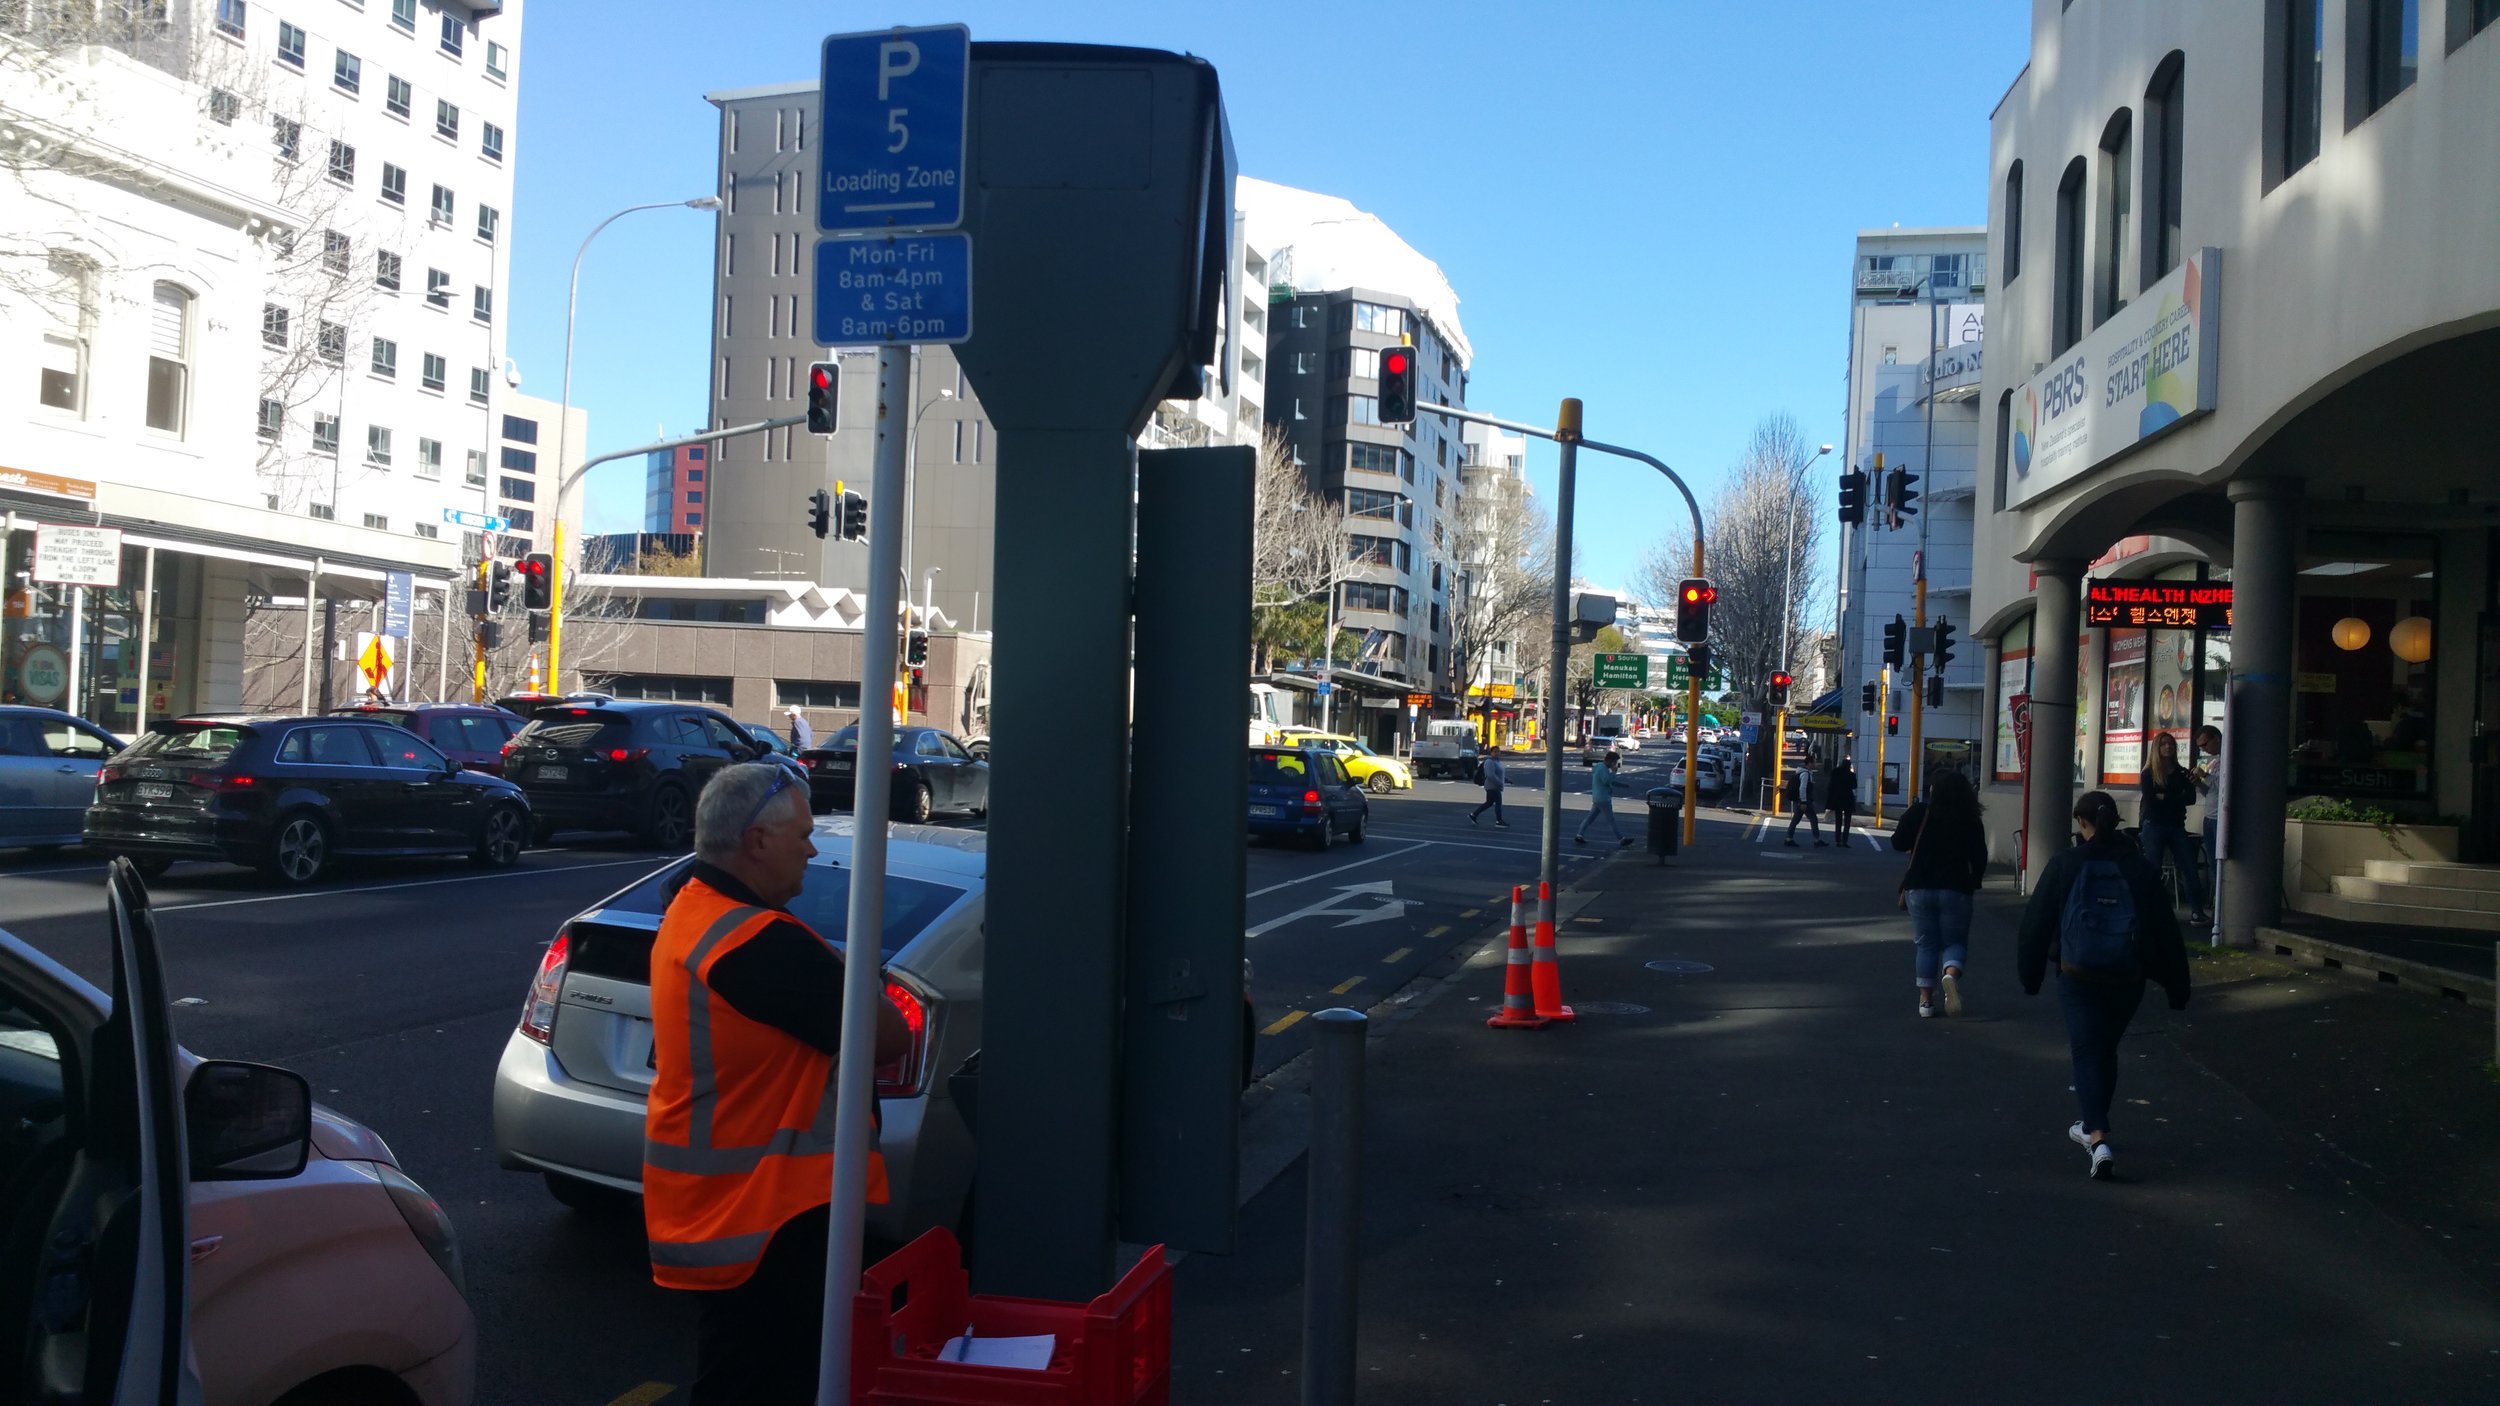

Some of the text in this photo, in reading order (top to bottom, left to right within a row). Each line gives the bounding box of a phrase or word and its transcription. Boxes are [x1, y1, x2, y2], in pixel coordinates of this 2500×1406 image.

[878, 40, 921, 101] P
[887, 108, 909, 153] 5
[827, 165, 955, 193] Loading Zone
[850, 243, 935, 265] Mon-Fri
[839, 268, 943, 289] 8am-4pm
[861, 292, 923, 311] & Sat
[841, 316, 945, 337] 8am-6pm
[2107, 338, 2138, 368] HOSPITALITY
[2144, 317, 2169, 344] COOKERY
[2106, 323, 2191, 408] START HERE
[84, 530, 101, 538] ONLY
[44, 546, 113, 557] STRAIGHT THROUGH
[72, 539, 104, 548] PROCEED
[39, 553, 116, 566] FROM THE LEFT LANE
[59, 572, 74, 580] MON
[83, 573, 95, 582] FRI
[2112, 638, 2133, 652] WOMENS
[1603, 663, 1638, 672] Manukau
[1603, 672, 1638, 680] Hamilton
[29, 670, 60, 687] VISAS
[2341, 769, 2392, 787] Sushi
